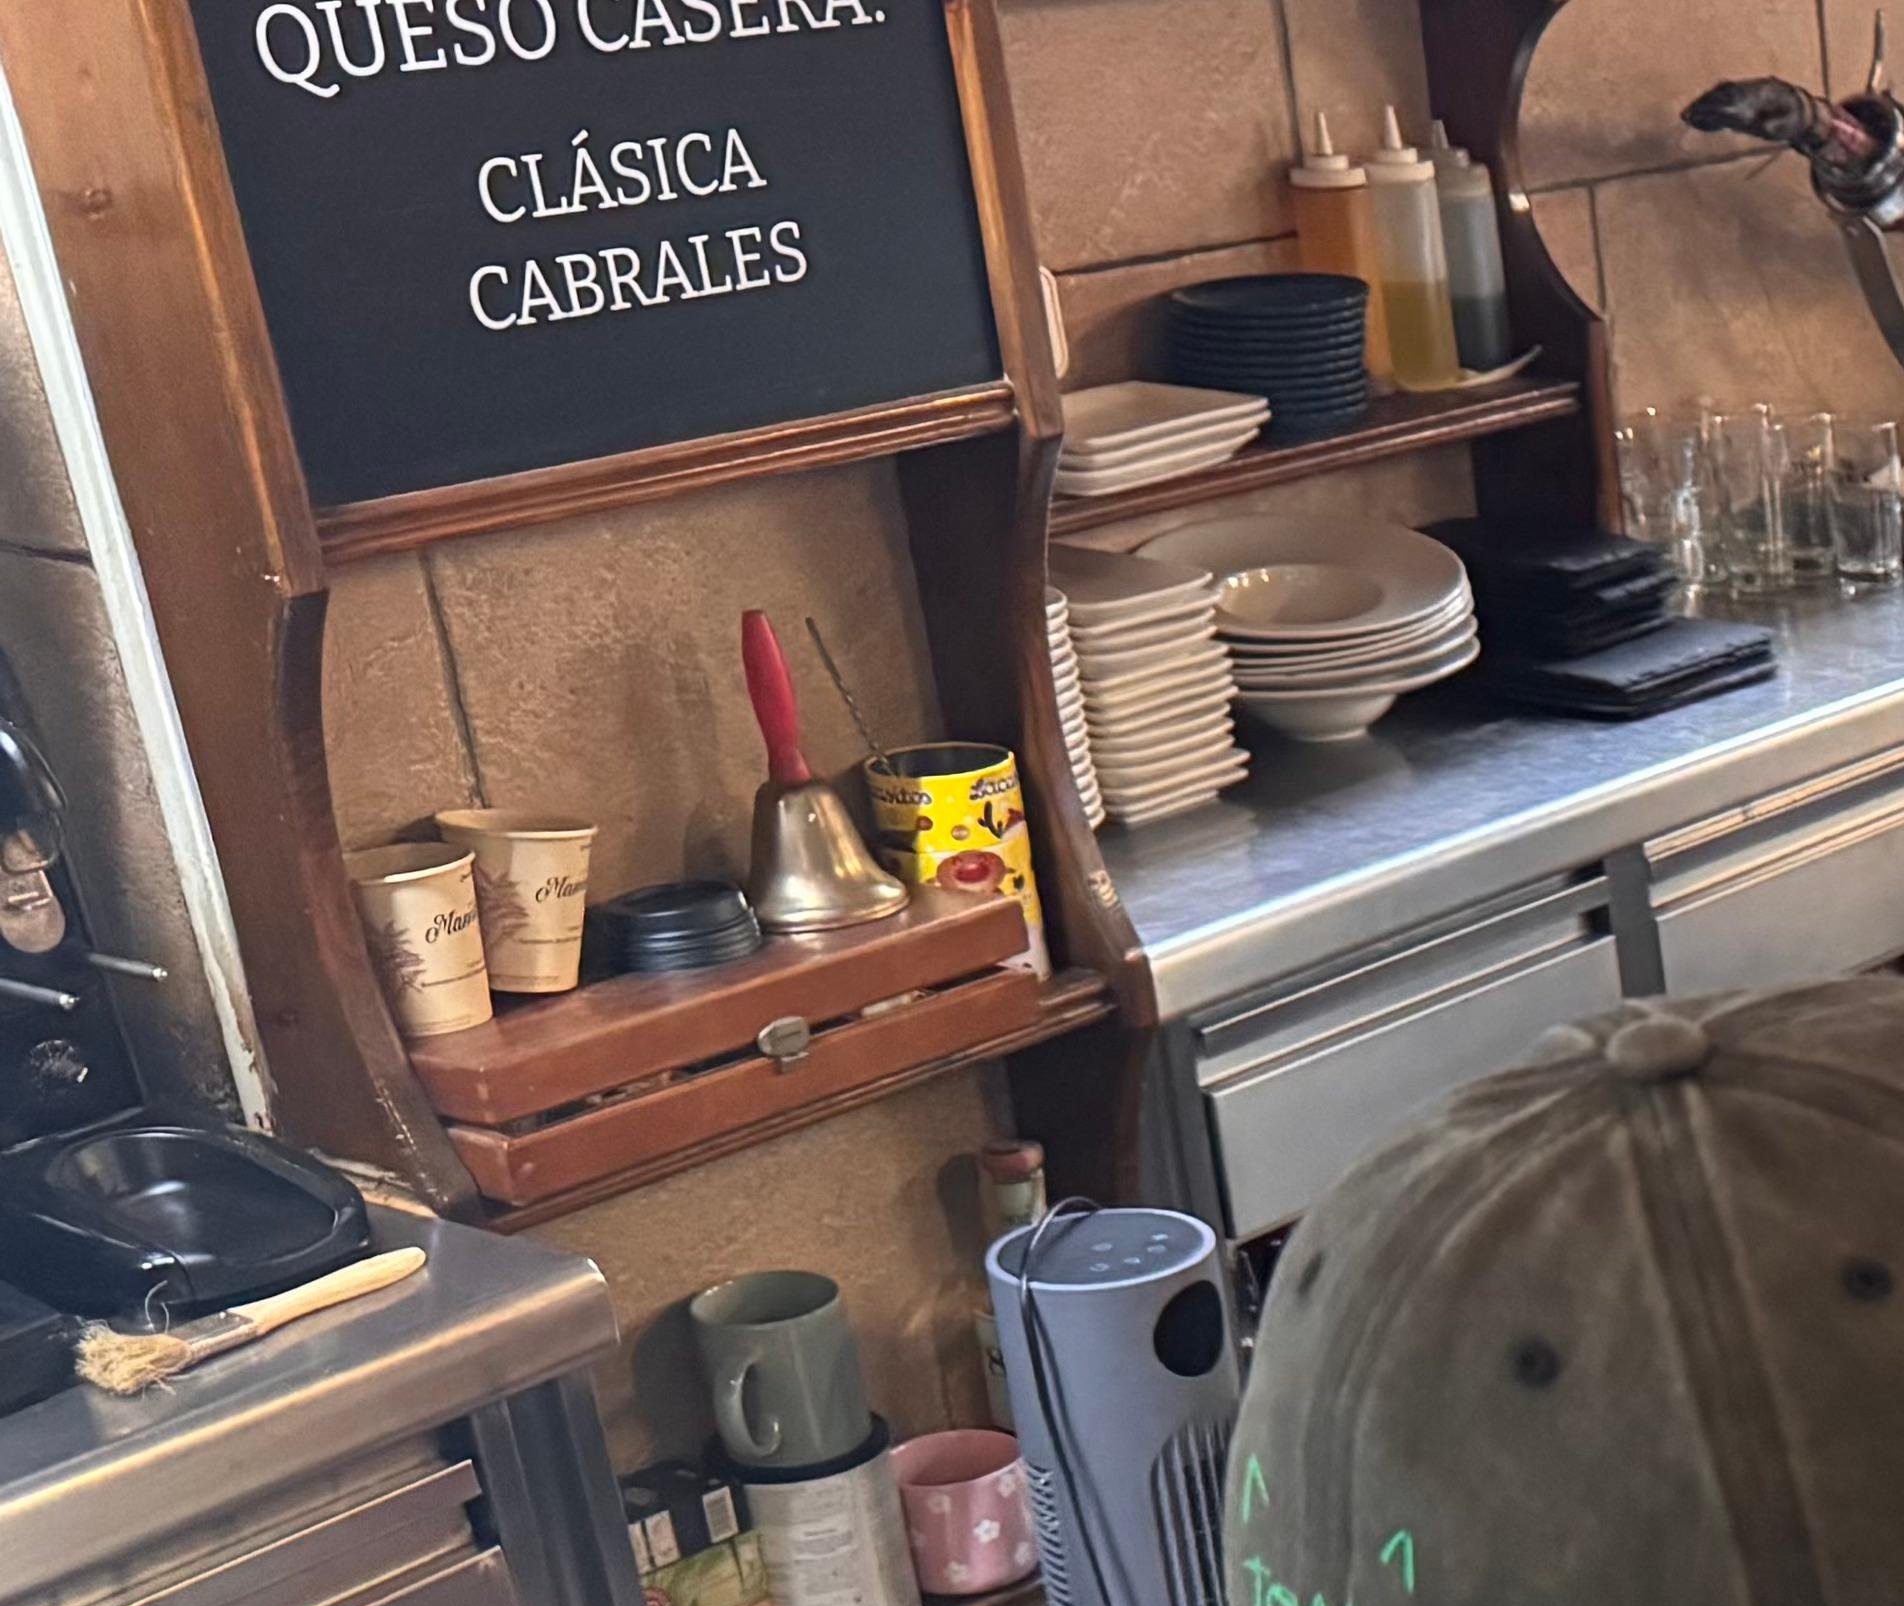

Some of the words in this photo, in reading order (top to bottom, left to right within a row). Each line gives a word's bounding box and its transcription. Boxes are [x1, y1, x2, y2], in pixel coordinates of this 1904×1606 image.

[255, 0, 557, 97] QUESO
[477, 129, 766, 223] CLÁSICA
[468, 220, 808, 330] CABRALES
